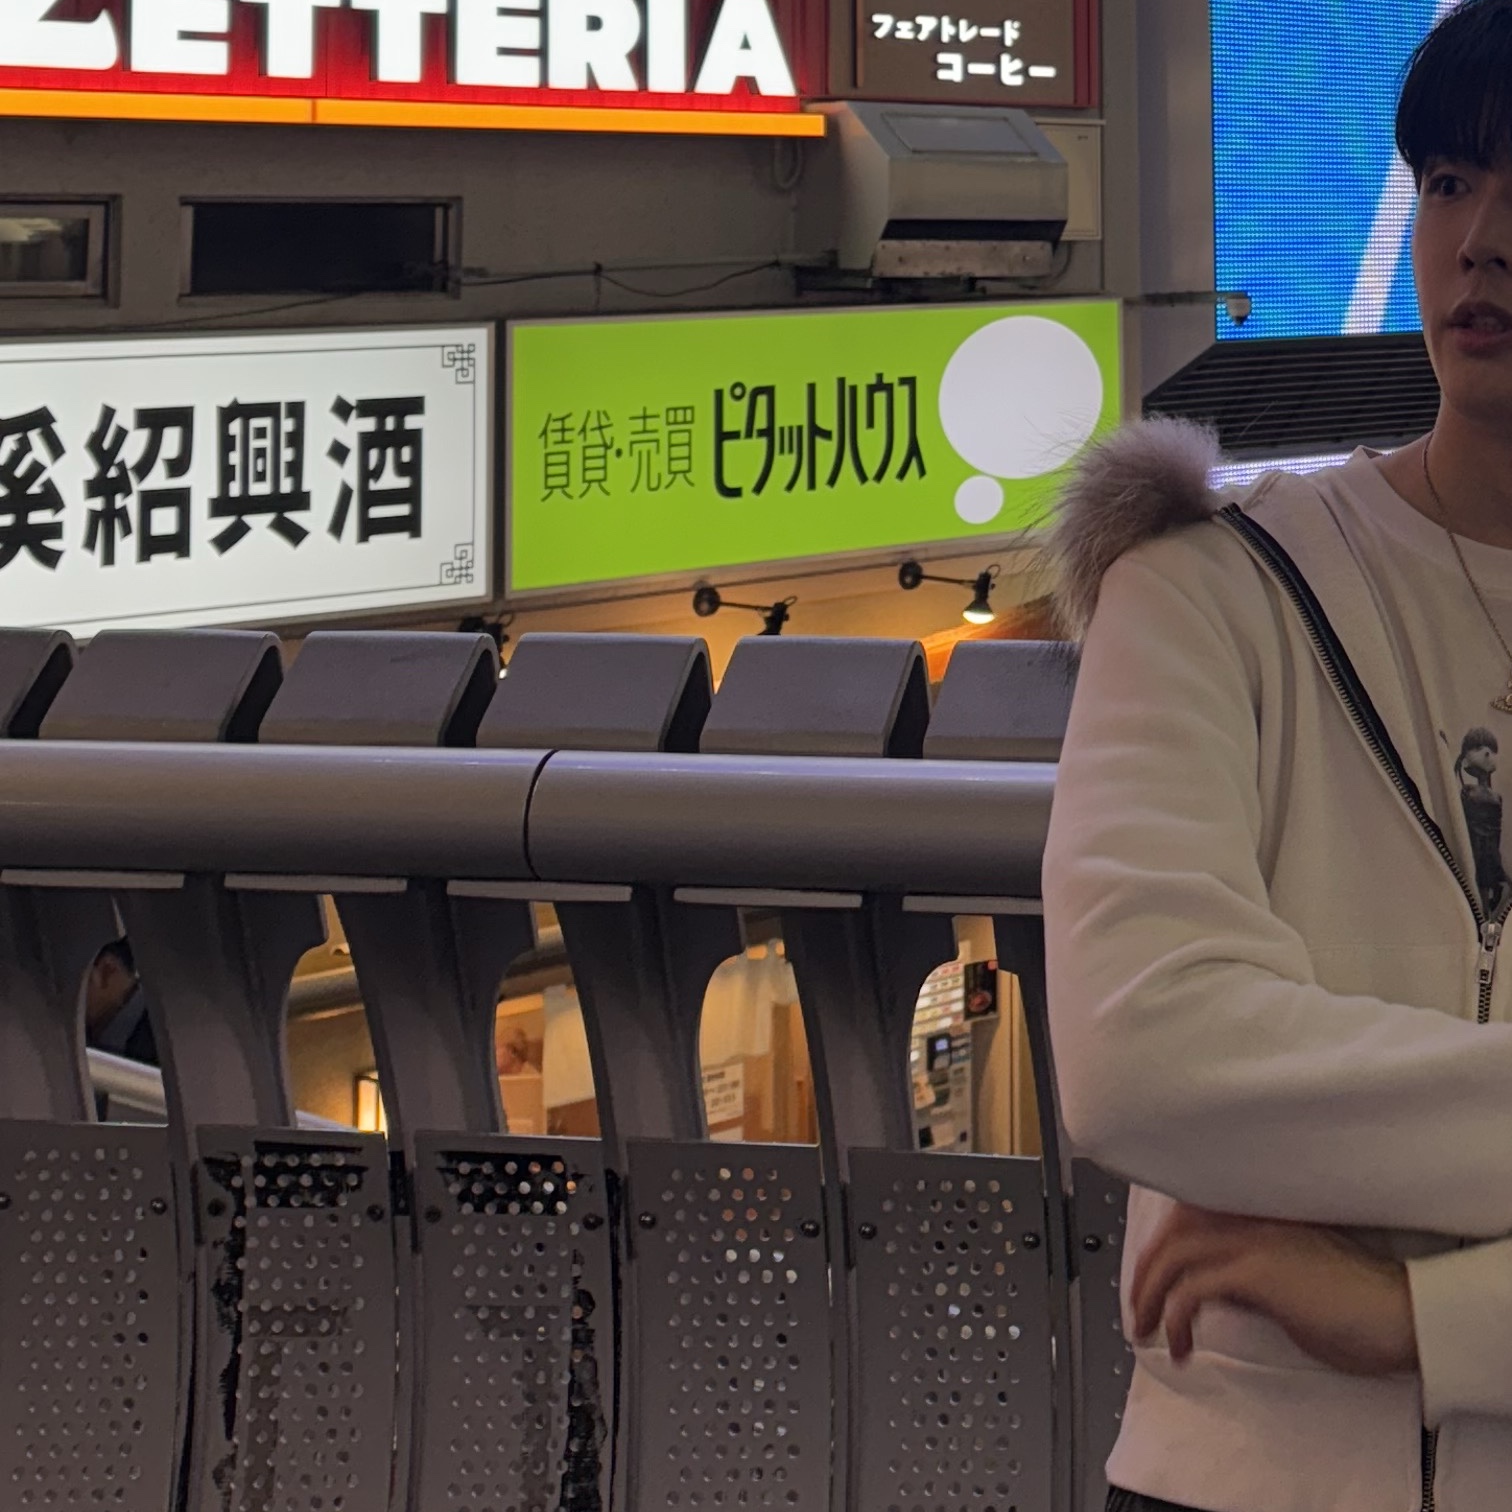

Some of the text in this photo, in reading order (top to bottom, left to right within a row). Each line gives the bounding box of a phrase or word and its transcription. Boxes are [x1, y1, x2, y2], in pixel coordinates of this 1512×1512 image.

[872, 14, 1021, 47] フェアトレード
[936, 53, 1057, 86] コーヒー
[714, 372, 927, 498] ピタットハウス
